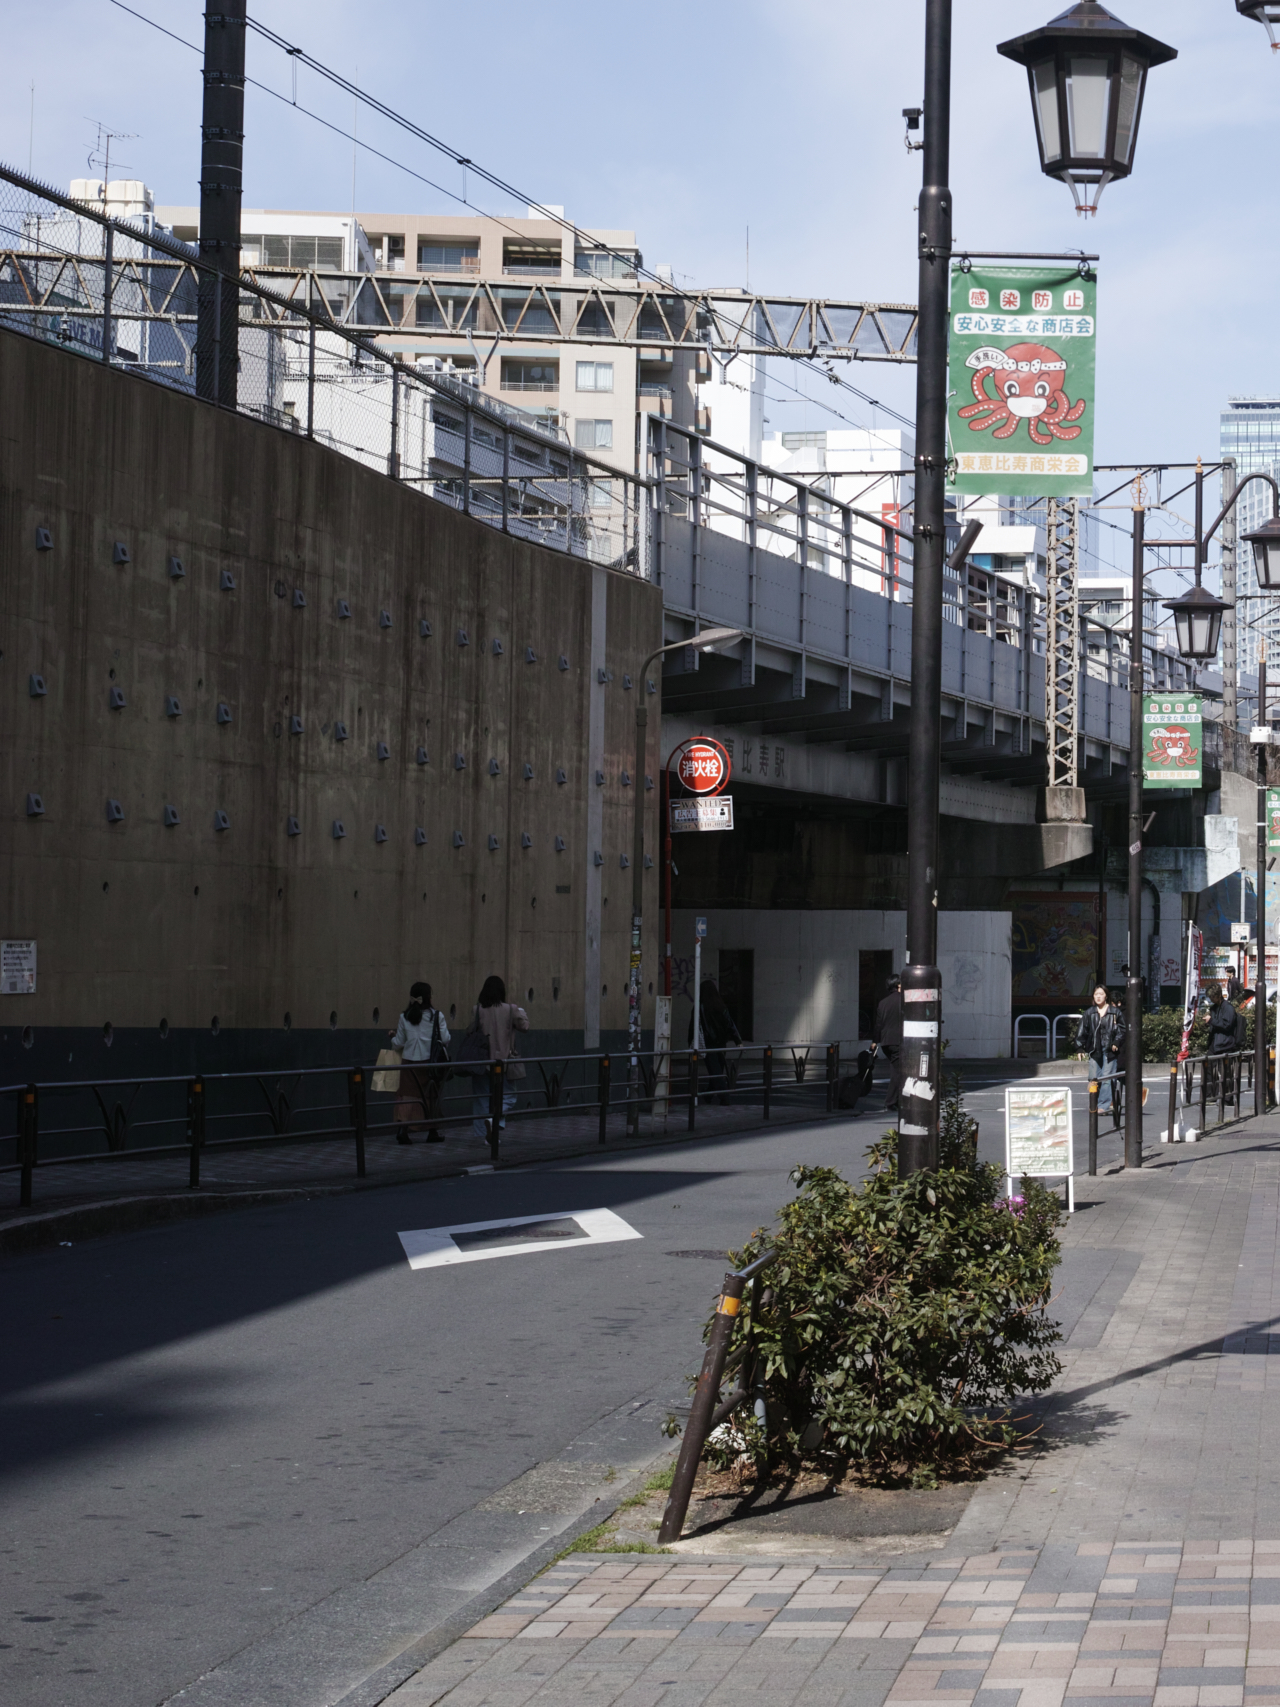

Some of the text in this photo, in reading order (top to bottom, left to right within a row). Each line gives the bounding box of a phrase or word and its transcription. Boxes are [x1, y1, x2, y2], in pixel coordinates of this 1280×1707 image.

[970, 289, 1082, 308] 感染防止
[957, 315, 1091, 334] 安心安全な商店会
[974, 352, 999, 363] 手洗い
[961, 455, 1081, 474] 東恵比寿商栄会
[682, 759, 719, 778] 消火栓
[681, 800, 722, 808] WANTED
